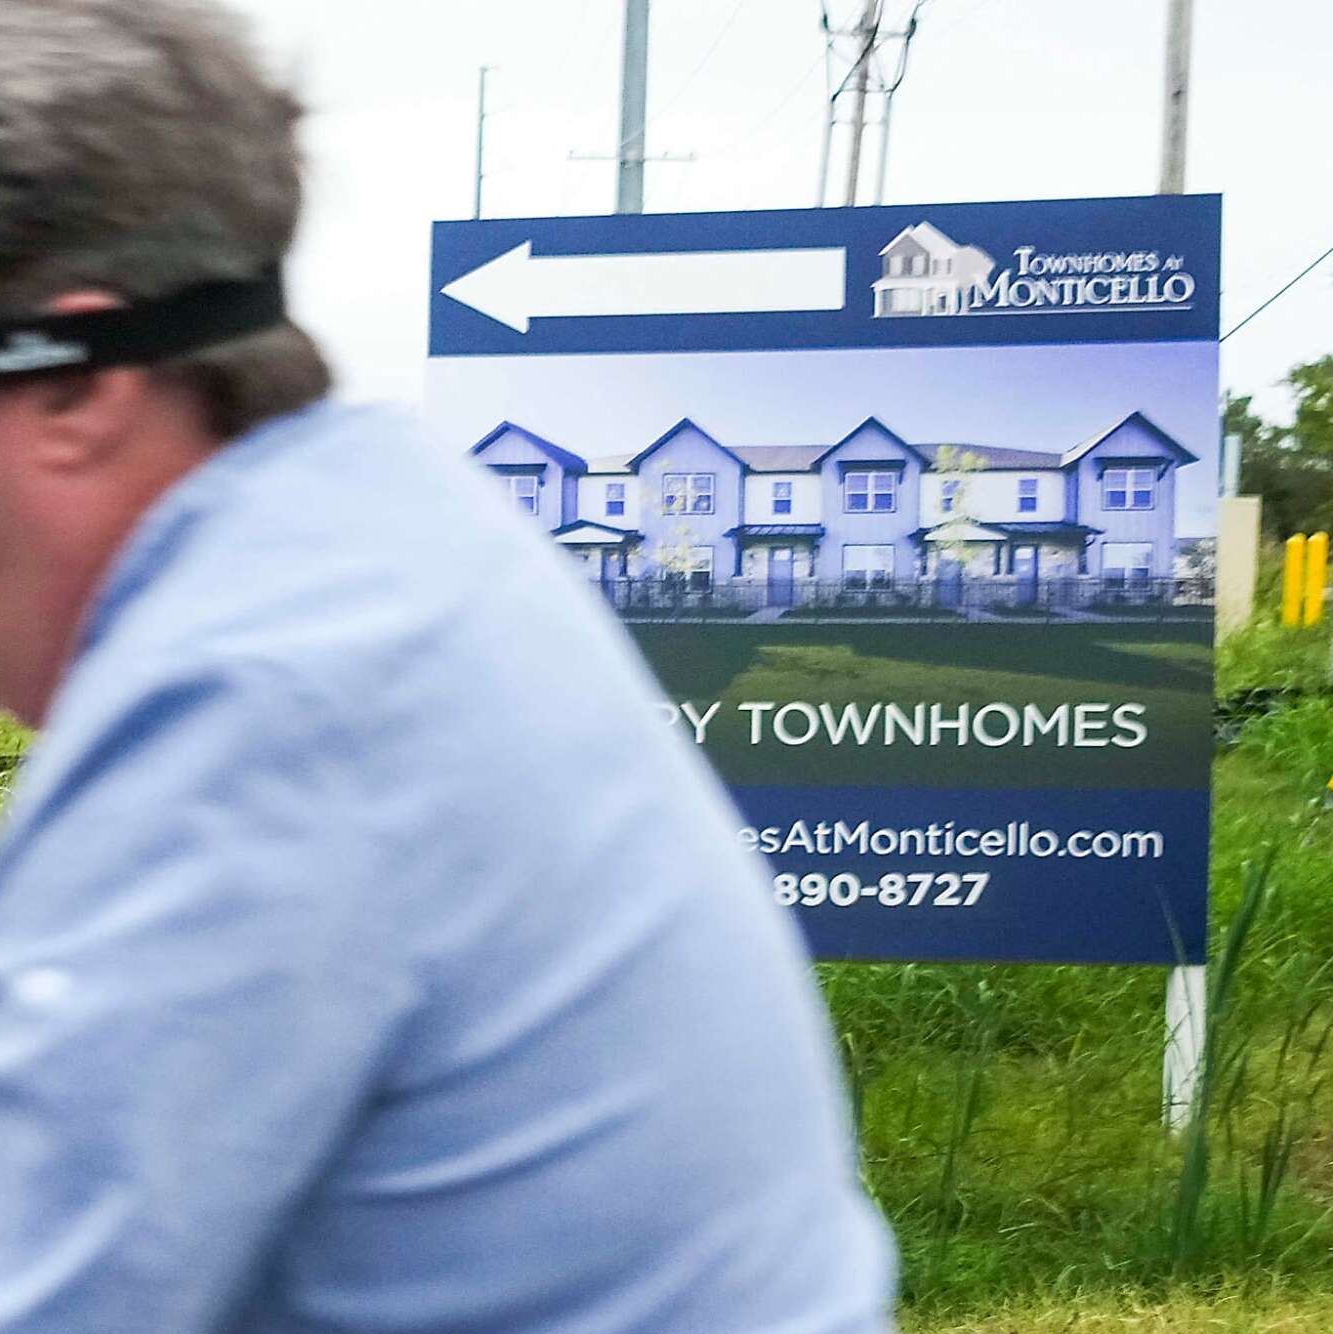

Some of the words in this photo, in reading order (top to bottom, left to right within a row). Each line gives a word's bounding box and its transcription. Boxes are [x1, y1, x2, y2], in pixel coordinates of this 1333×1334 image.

[969, 268, 1195, 308] MONTICELLO
[737, 701, 1149, 748] TOWNHOMES
[773, 871, 991, 907] 890-8727
